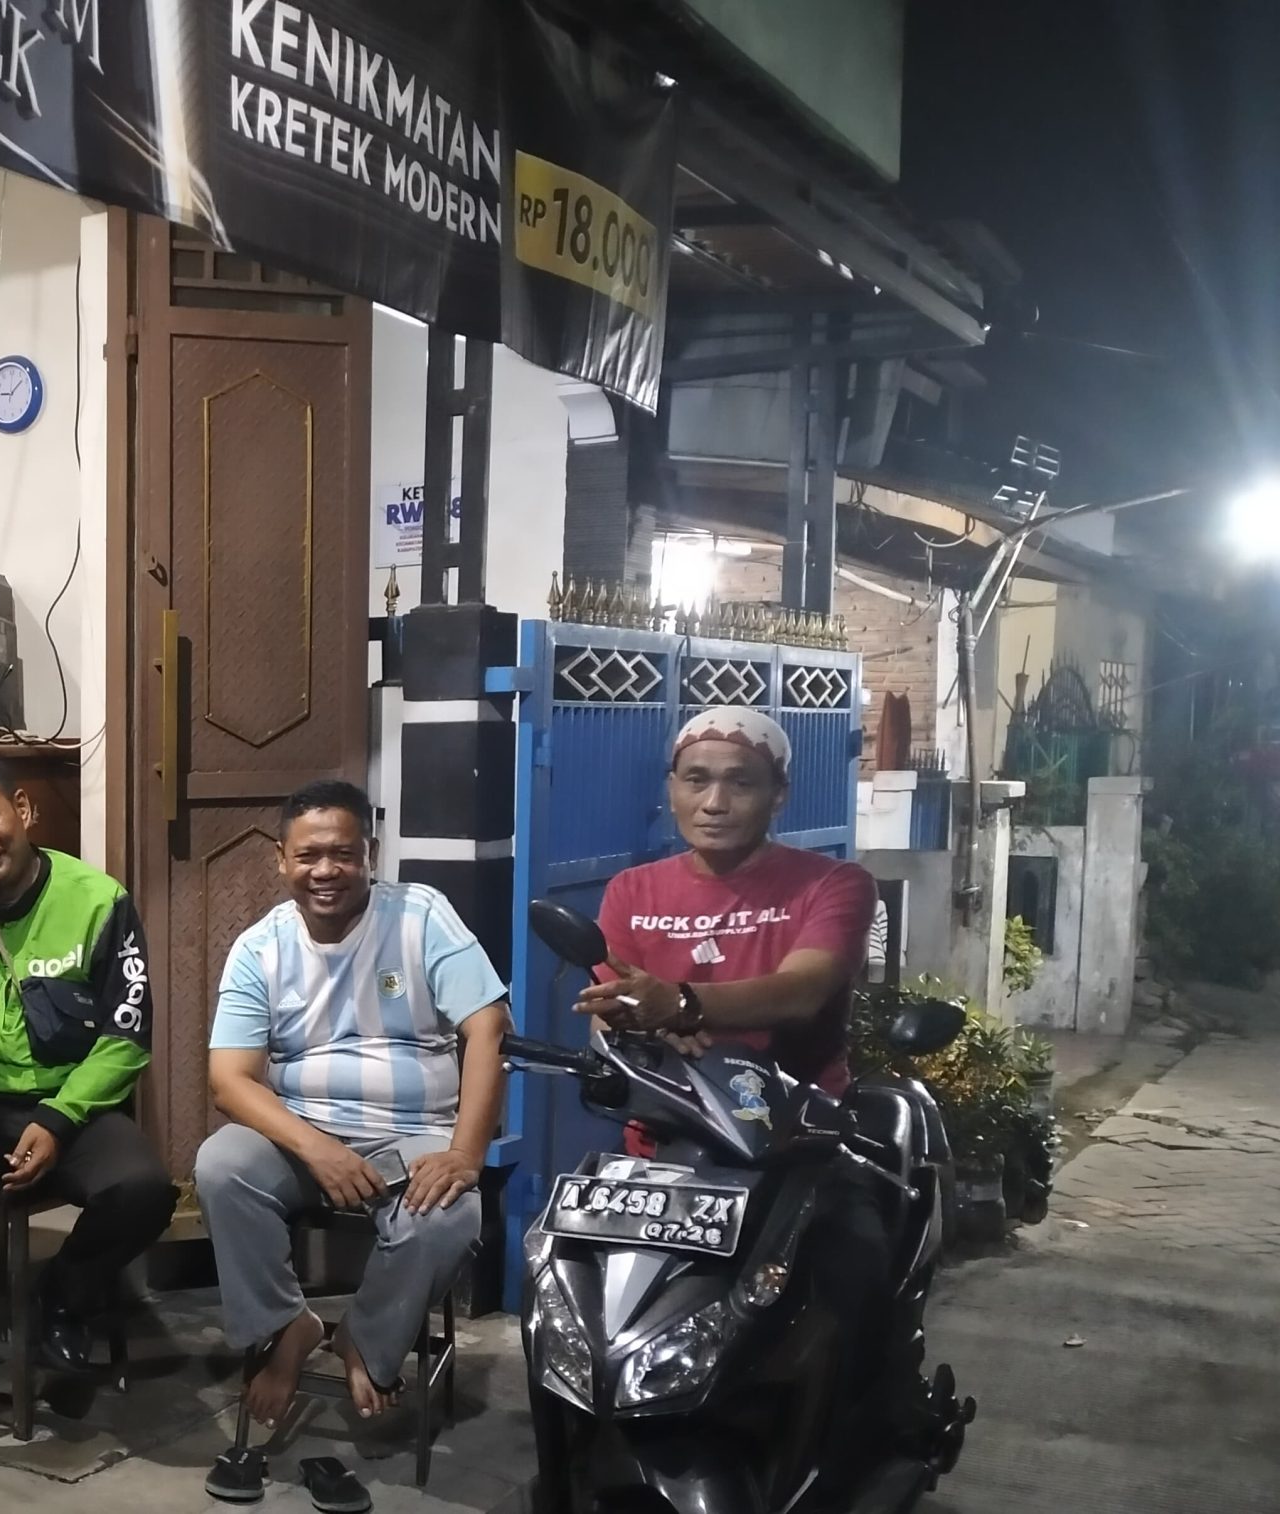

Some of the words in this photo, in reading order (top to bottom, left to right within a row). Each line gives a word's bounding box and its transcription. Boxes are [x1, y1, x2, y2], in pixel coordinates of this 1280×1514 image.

[230, 0, 501, 185] KENIKMATAN
[230, 75, 374, 186] KRETEK
[383, 142, 502, 244] MODERN
[520, 192, 547, 229] RP
[552, 187, 651, 299] 18.000
[386, 501, 424, 525] RW
[631, 915, 690, 931] FUCK
[694, 914, 723, 930] OF
[728, 911, 753, 926] IT
[756, 907, 791, 924] ALL
[723, 1057, 771, 1077] HONDA
[558, 1182, 581, 1211] A
[589, 1187, 667, 1217] 6458
[692, 1195, 735, 1223] ZX
